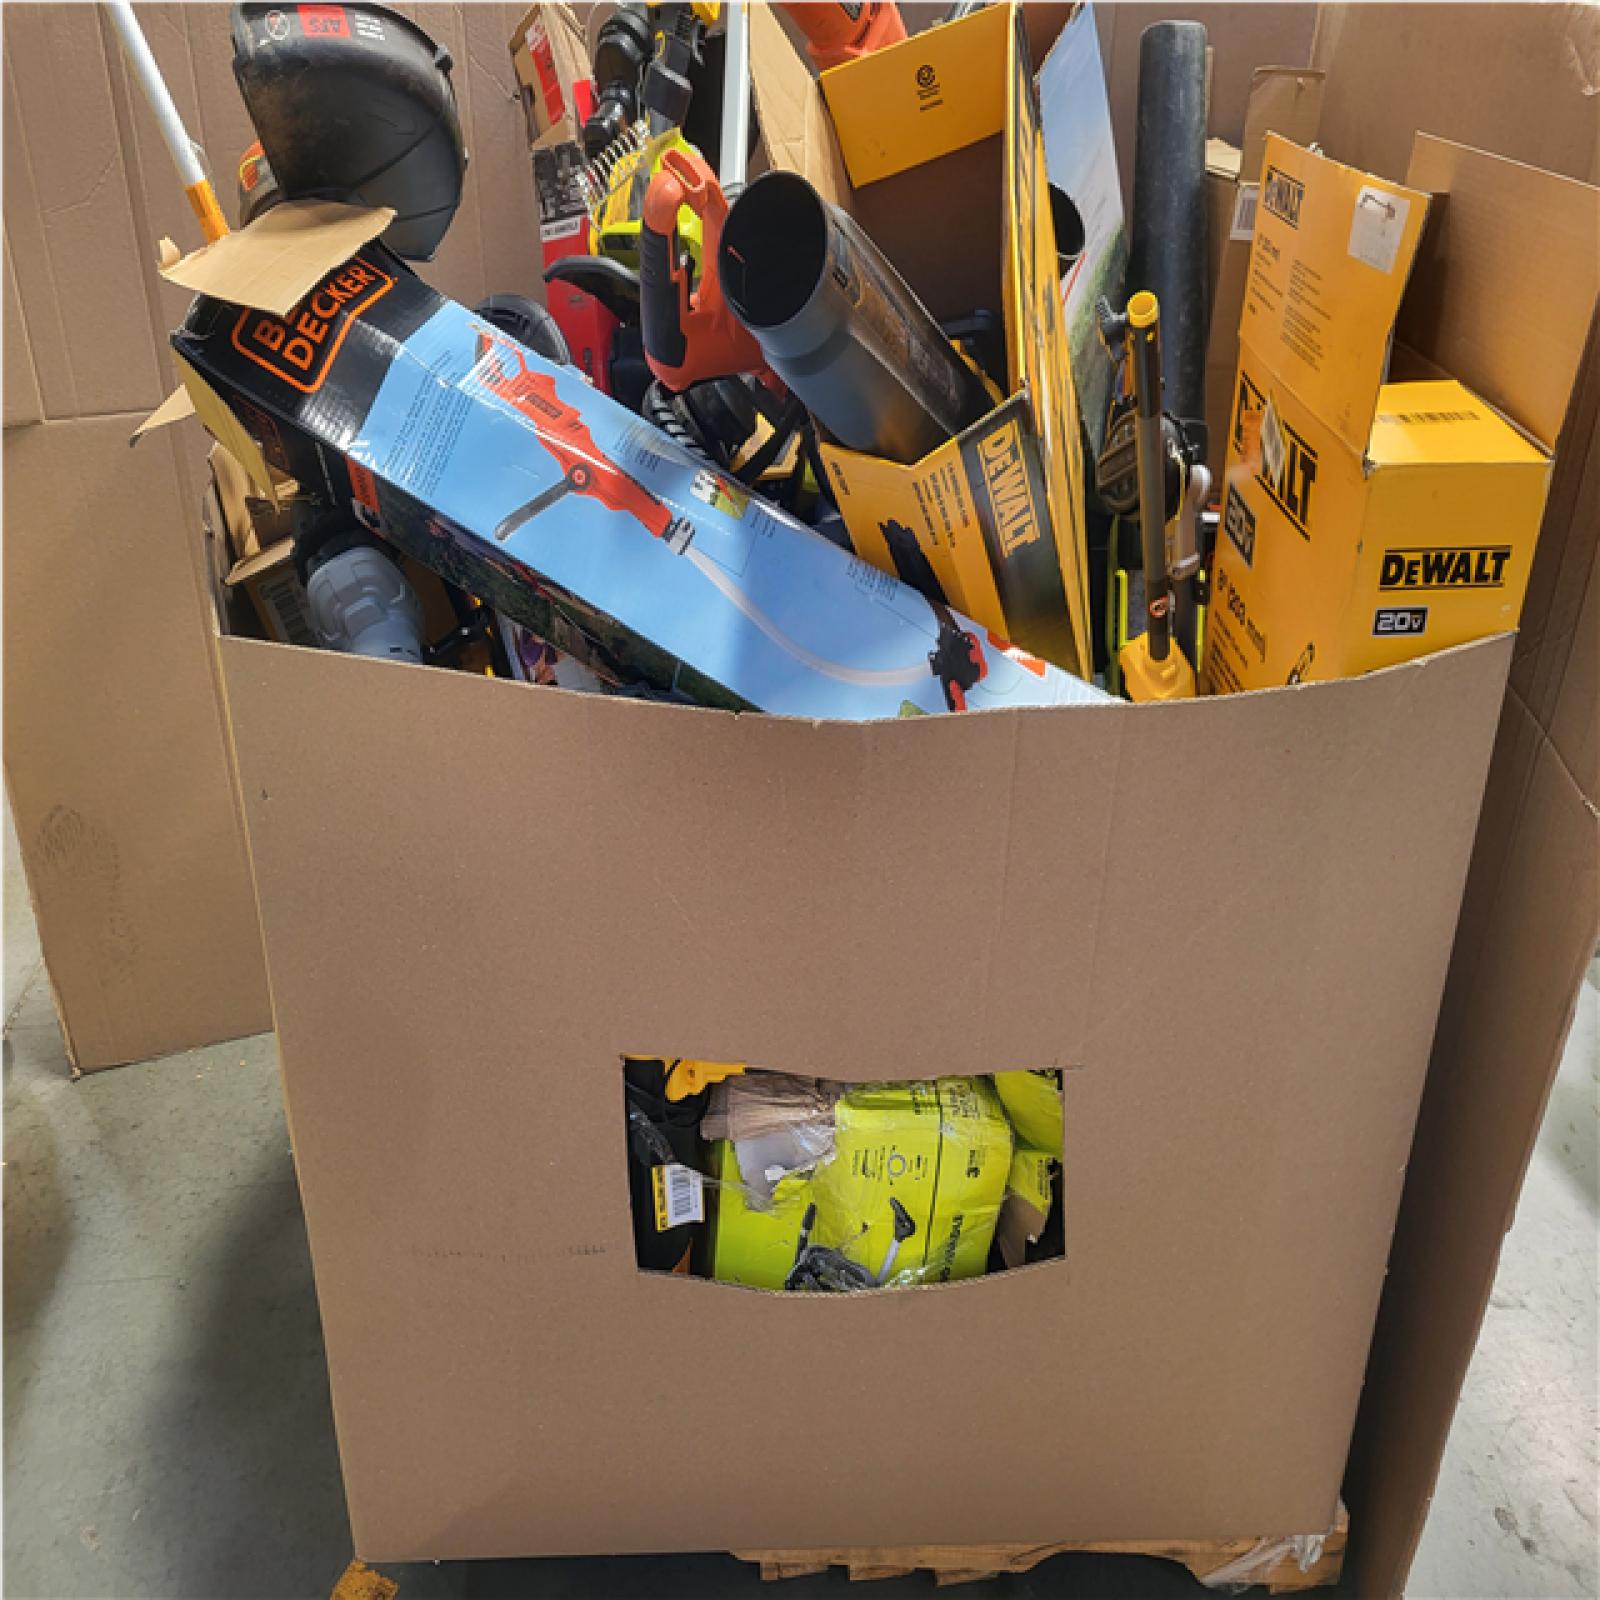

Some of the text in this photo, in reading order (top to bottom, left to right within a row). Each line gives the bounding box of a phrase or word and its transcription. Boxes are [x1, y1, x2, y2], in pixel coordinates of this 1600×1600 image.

[282, 265, 376, 371] DECKER
[980, 420, 1038, 555] DEWALT
[1380, 549, 1511, 587] DEWALT
